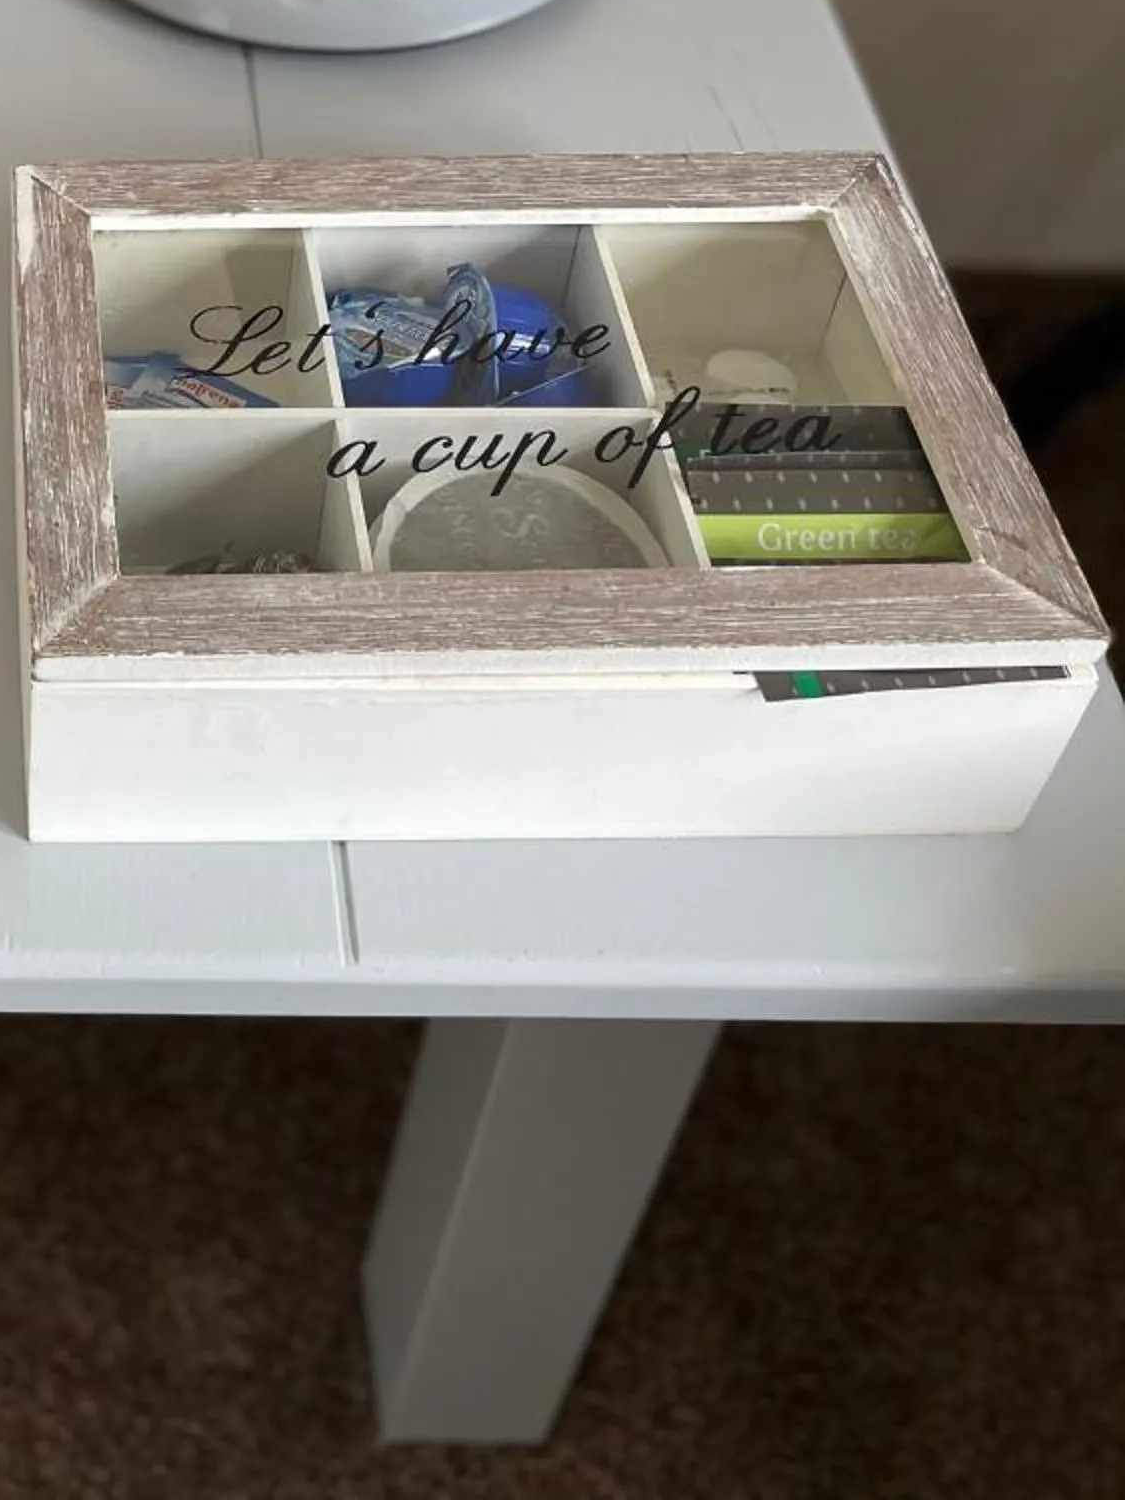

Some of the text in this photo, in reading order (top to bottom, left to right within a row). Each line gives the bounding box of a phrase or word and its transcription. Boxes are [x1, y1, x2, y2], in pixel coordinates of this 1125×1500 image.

[413, 299, 612, 366] have
[326, 386, 842, 496] a cup of tea
[757, 522, 856, 552] Green
